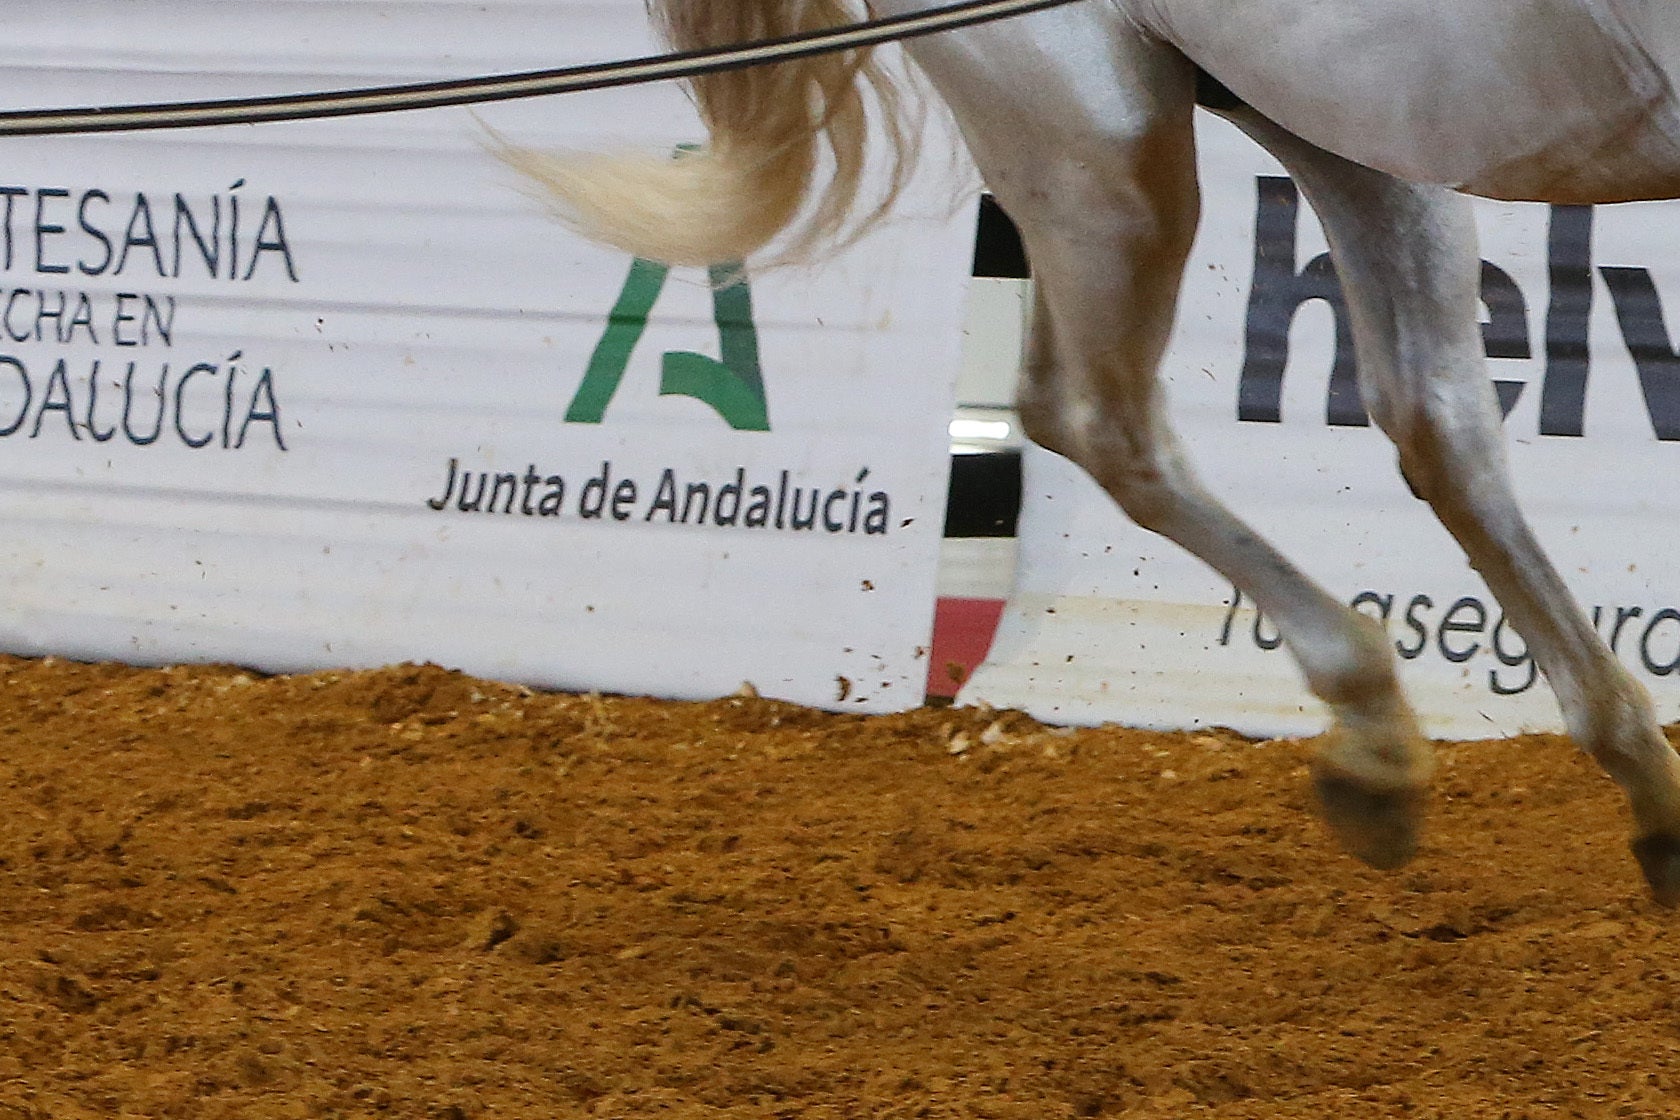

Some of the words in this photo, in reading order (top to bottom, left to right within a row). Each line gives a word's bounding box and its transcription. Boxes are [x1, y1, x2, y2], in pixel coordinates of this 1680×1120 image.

[0, 286, 99, 345] CHA
[113, 293, 176, 347] EN
[426, 457, 565, 516] Junta
[579, 460, 637, 522] de
[645, 466, 891, 536] Andalucía
